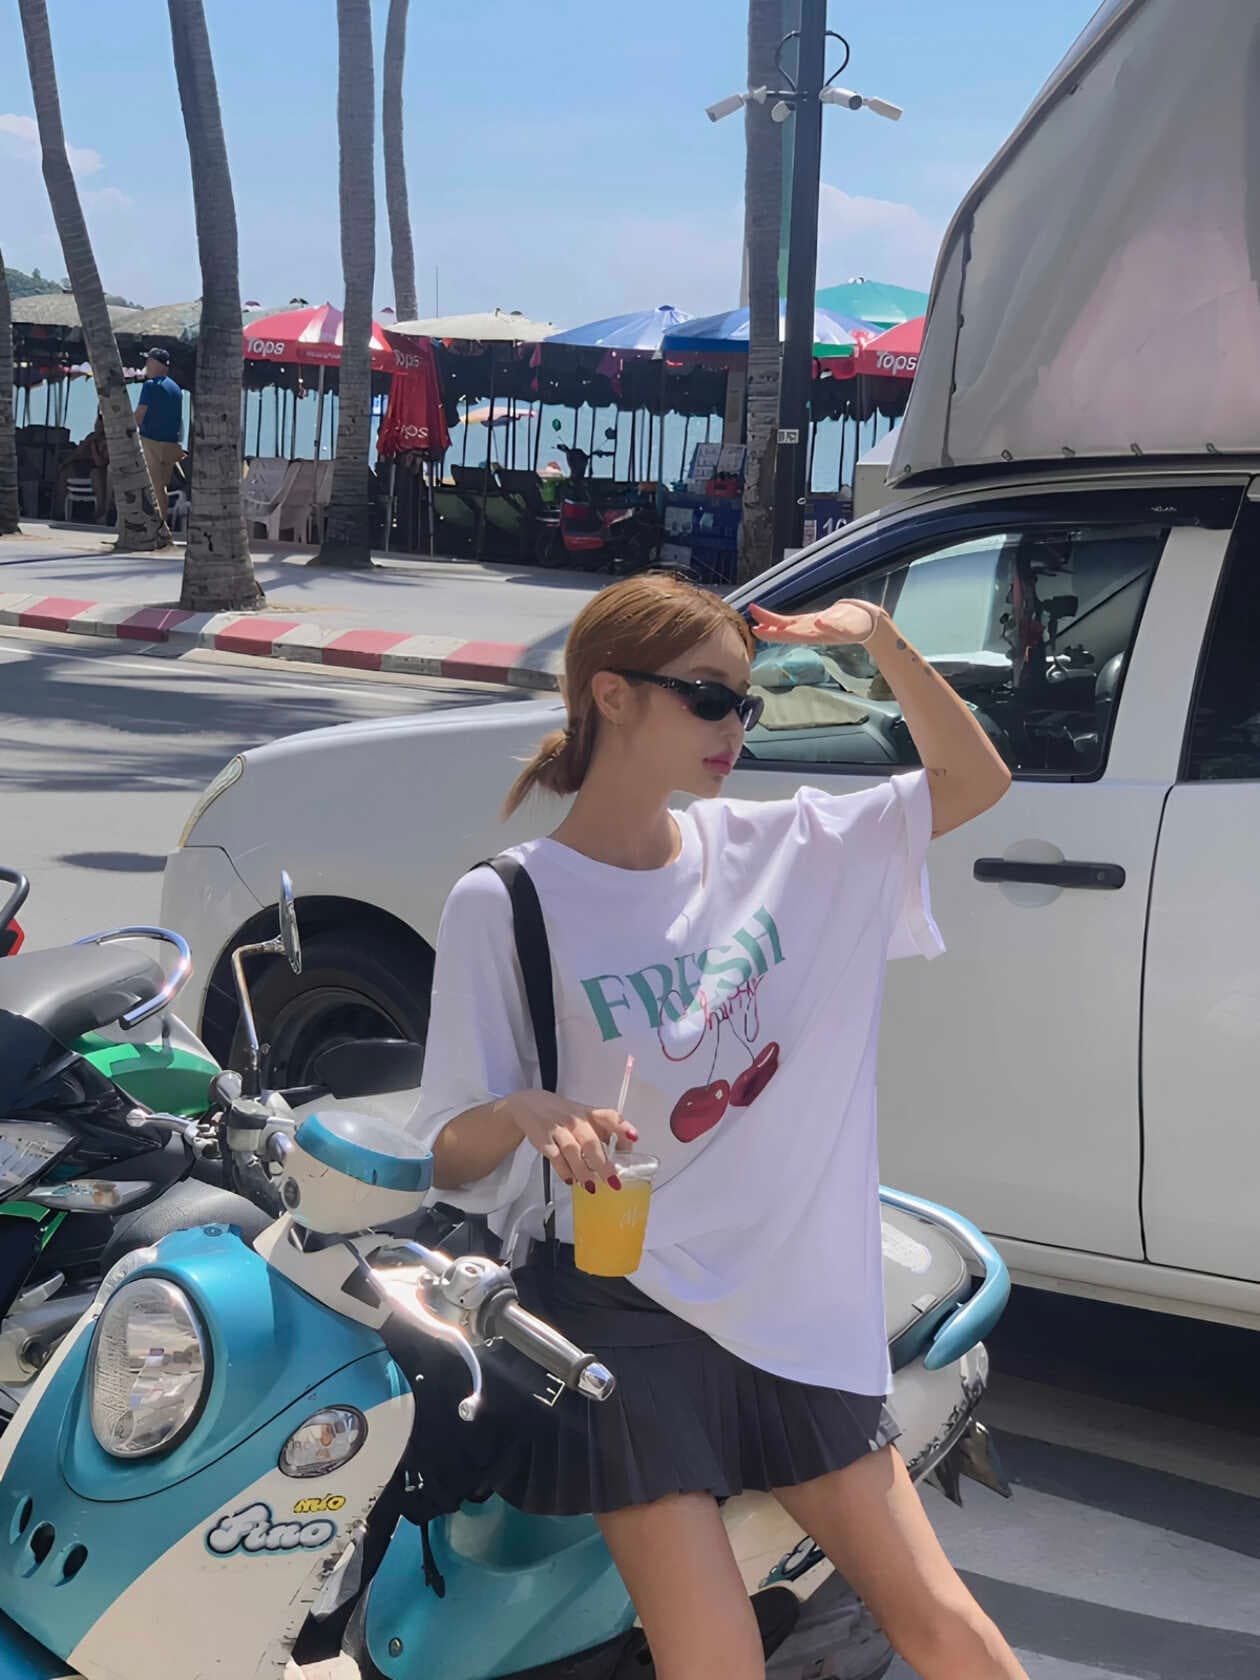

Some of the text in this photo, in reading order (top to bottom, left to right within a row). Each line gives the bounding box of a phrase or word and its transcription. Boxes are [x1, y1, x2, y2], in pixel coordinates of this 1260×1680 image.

[876, 350, 918, 376] Tops
[580, 905, 786, 1042] FRESH
[293, 1493, 346, 1514] mio
[206, 1502, 337, 1555] Fino
